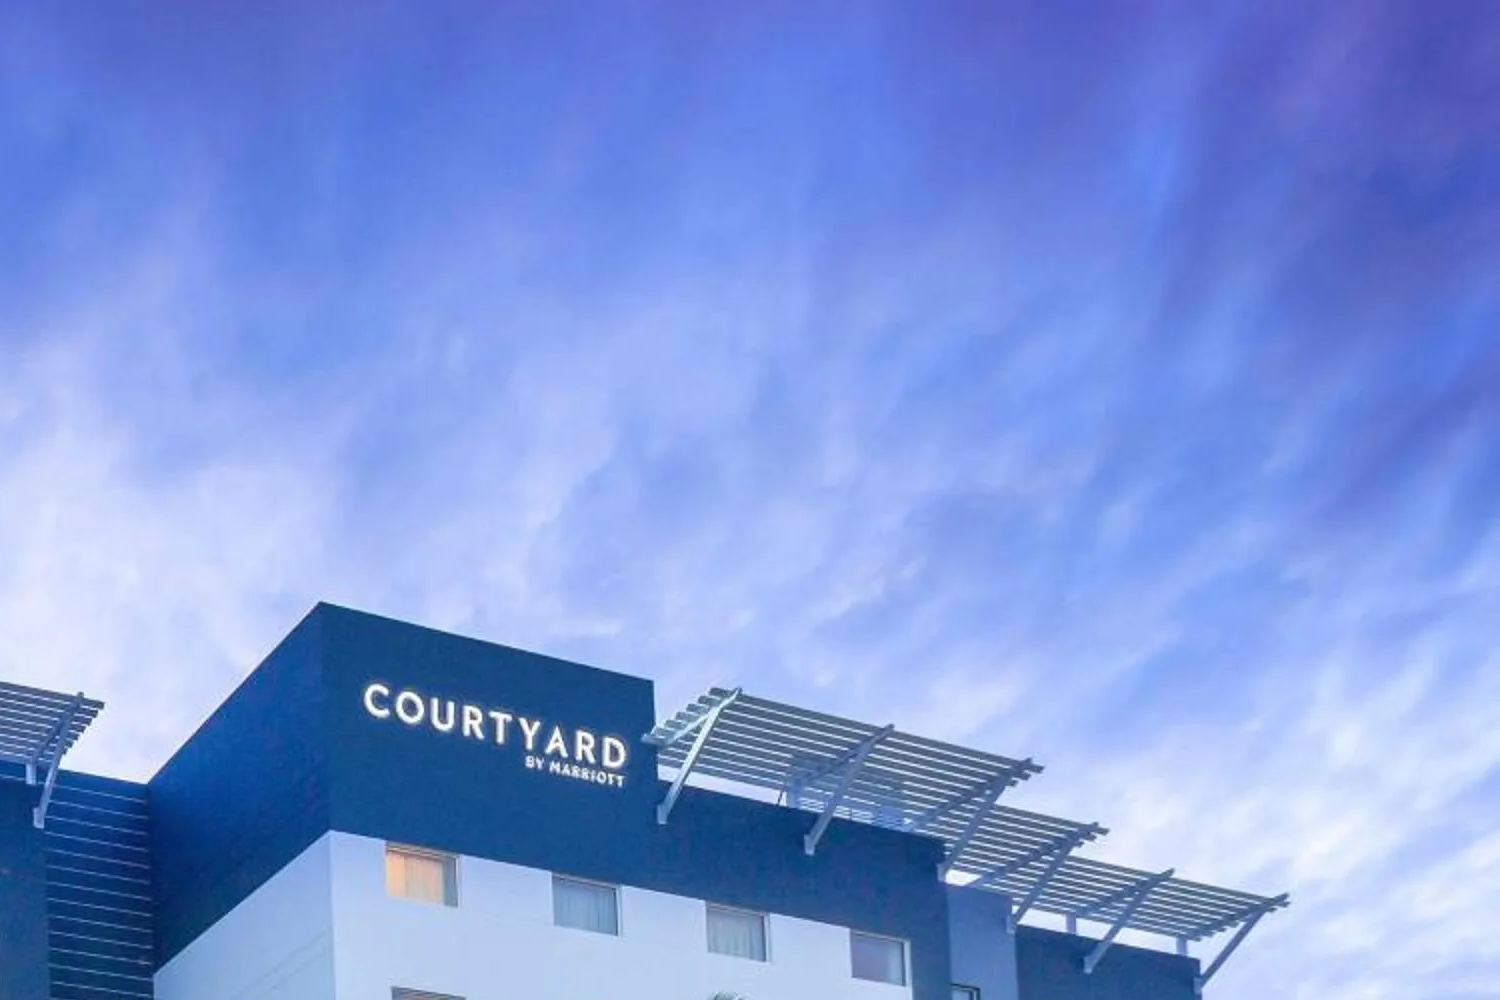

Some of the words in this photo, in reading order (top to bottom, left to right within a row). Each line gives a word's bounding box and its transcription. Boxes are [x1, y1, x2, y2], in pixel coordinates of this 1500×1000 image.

[363, 683, 628, 769] COURTYARD
[524, 755, 545, 770] BY
[549, 760, 626, 788] MARRIOTT
